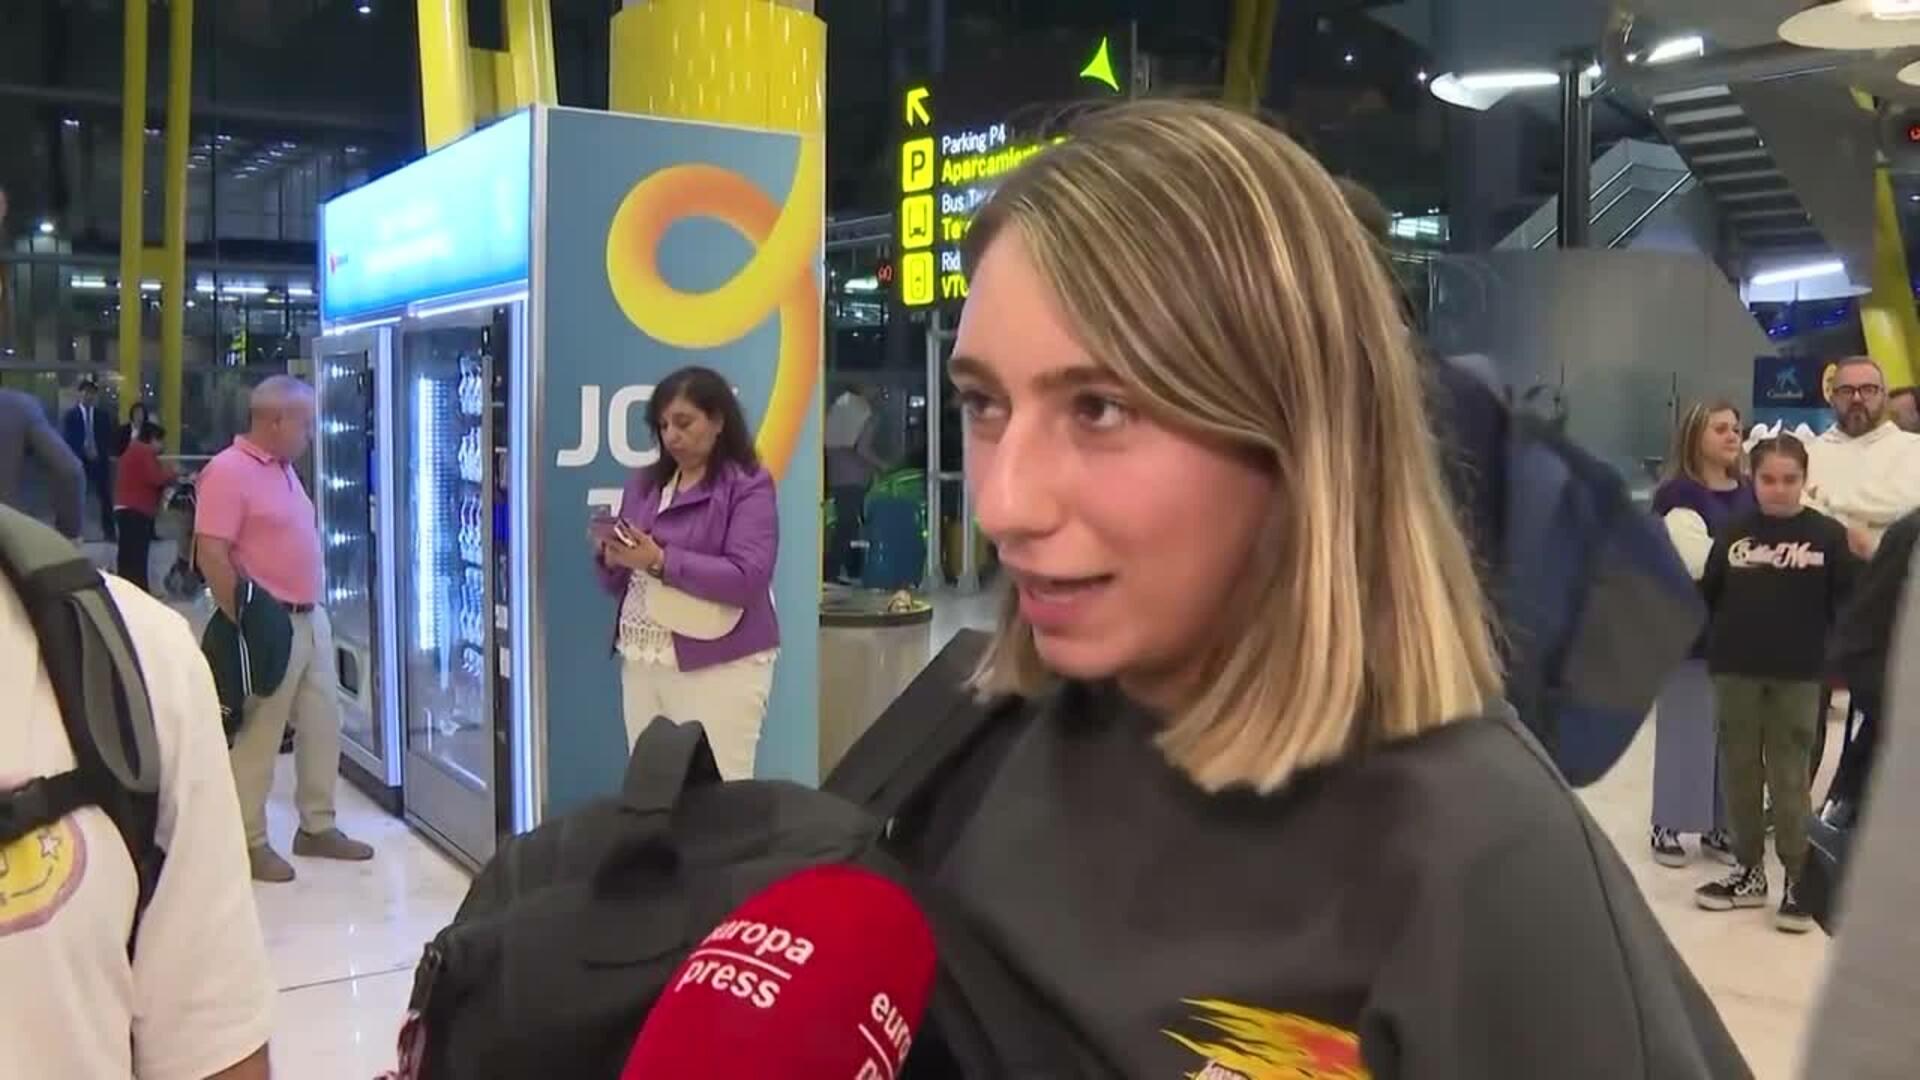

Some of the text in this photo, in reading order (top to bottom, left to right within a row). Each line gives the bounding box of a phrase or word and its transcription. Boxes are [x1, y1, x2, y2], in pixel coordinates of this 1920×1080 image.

[942, 123, 1006, 156] Parking P4
[941, 191, 964, 214] Bus
[674, 961, 781, 1008] press
